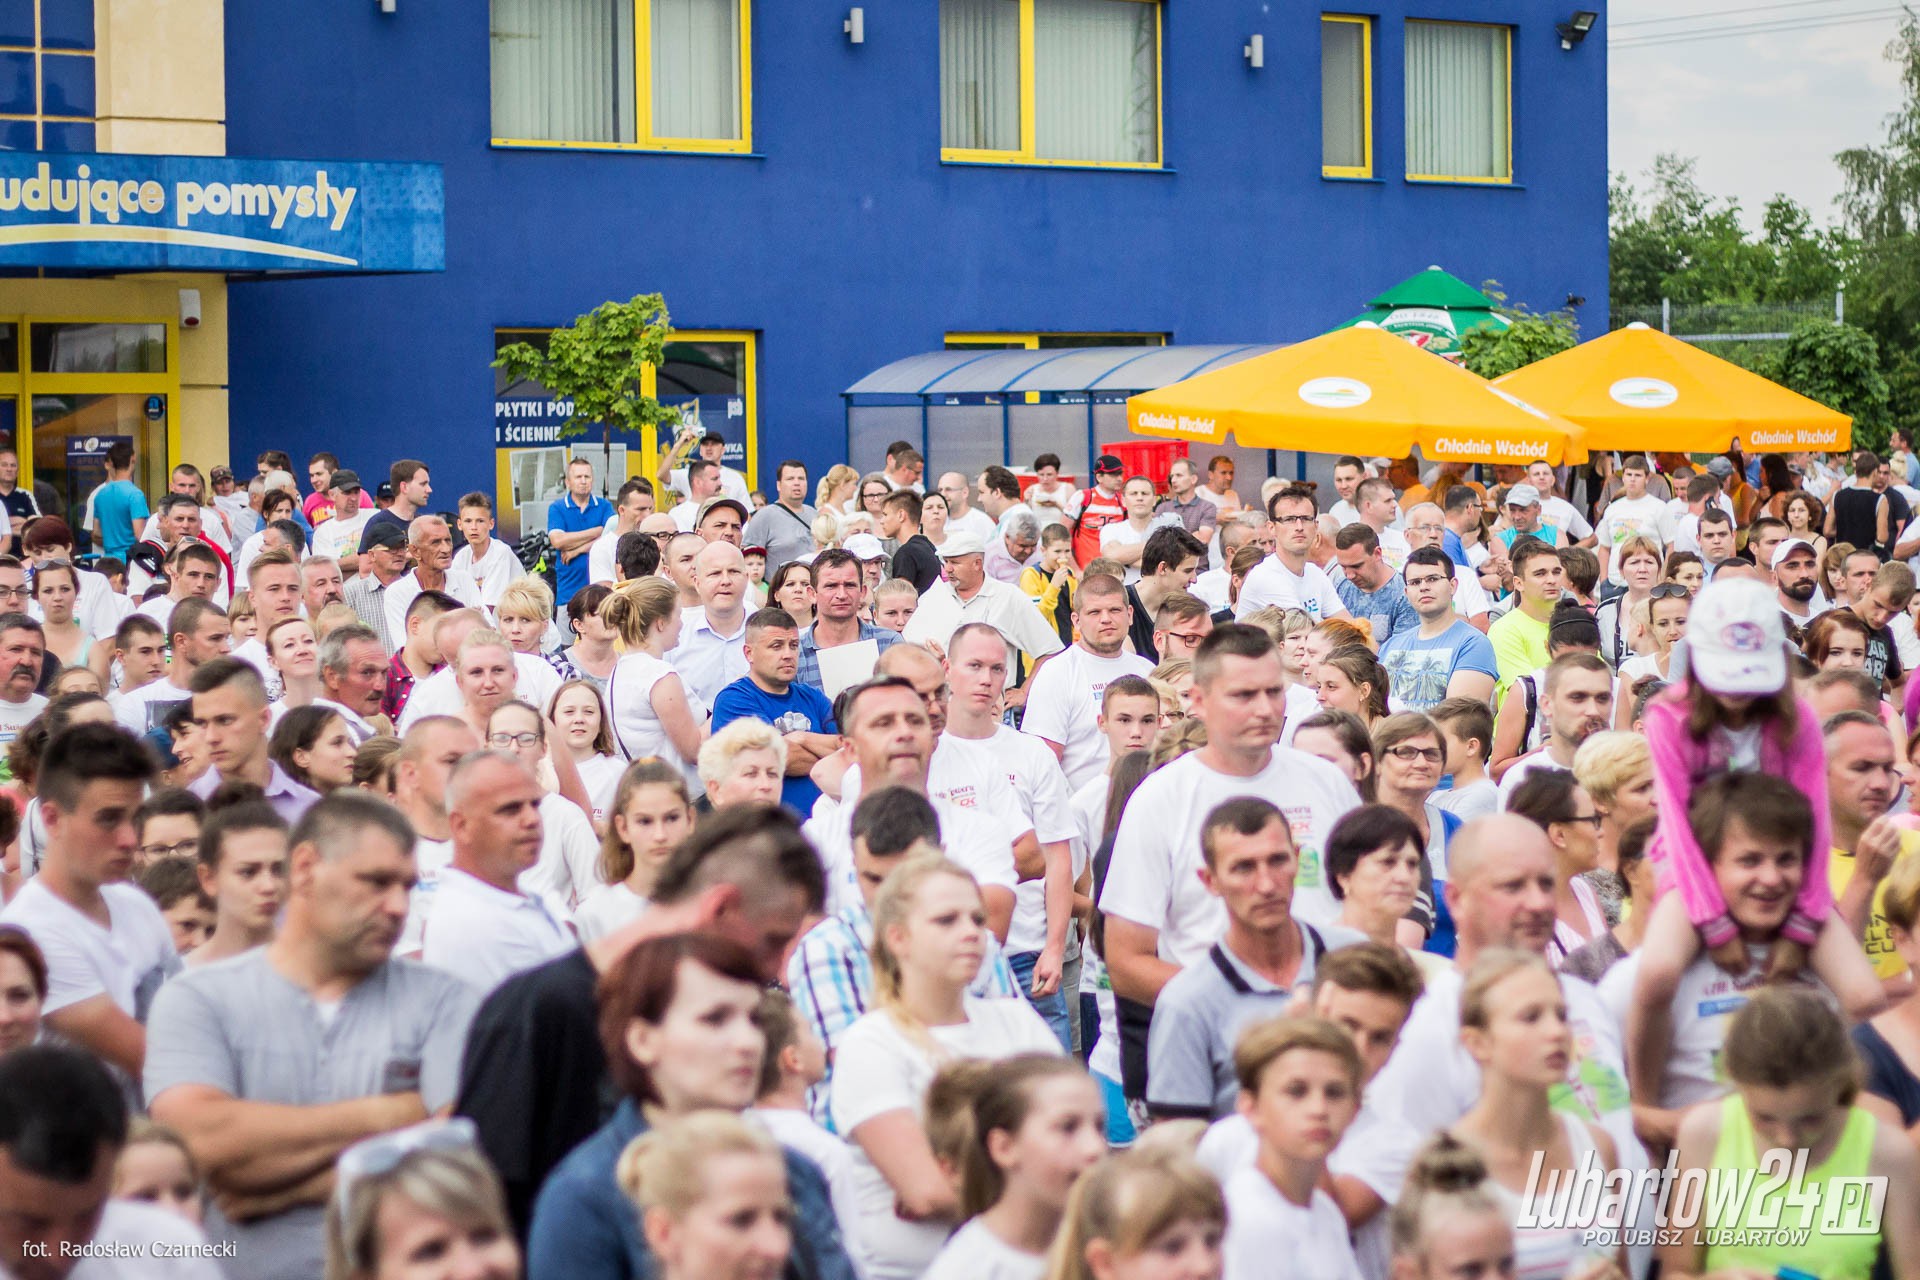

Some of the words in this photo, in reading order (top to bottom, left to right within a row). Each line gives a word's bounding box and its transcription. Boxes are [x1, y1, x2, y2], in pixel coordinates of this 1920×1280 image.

[176, 170, 357, 231] pomysły
[495, 401, 543, 417] PŁYTKI
[547, 401, 588, 417] POD
[505, 422, 562, 442] ŚCIENNE
[1138, 412, 1177, 431] Chłodnie
[1178, 415, 1216, 435] Wschód
[1751, 429, 1794, 445] Chłodnie
[1797, 427, 1837, 444] Wschód
[1435, 437, 1492, 455] Chłodnie
[1495, 439, 1549, 458] Wschód
